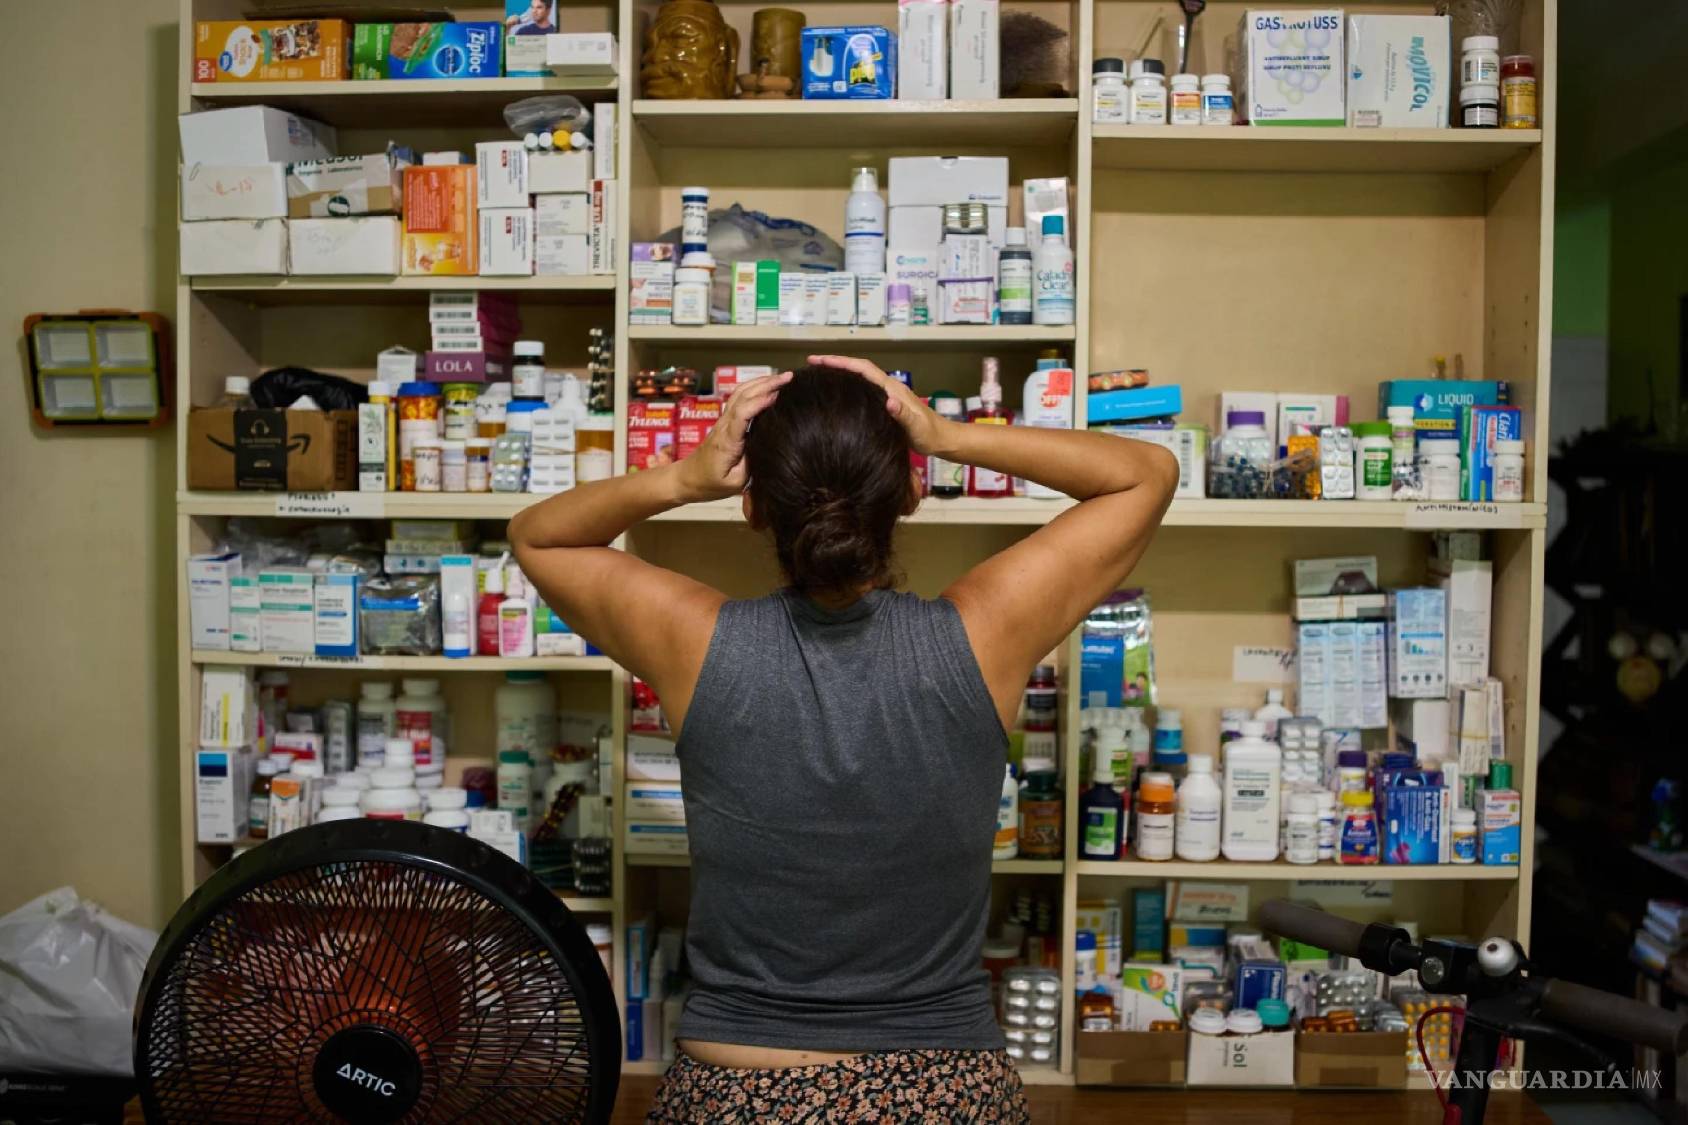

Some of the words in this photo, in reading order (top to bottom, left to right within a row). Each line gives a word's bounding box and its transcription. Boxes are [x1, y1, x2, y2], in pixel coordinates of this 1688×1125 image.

[465, 32, 486, 73] Ziploc
[198, 59, 210, 80] 100
[435, 361, 473, 373] LOLA
[1438, 394, 1475, 405] LIQUID
[1233, 1043, 1248, 1068] Sol
[336, 1063, 397, 1097] ARTIC
